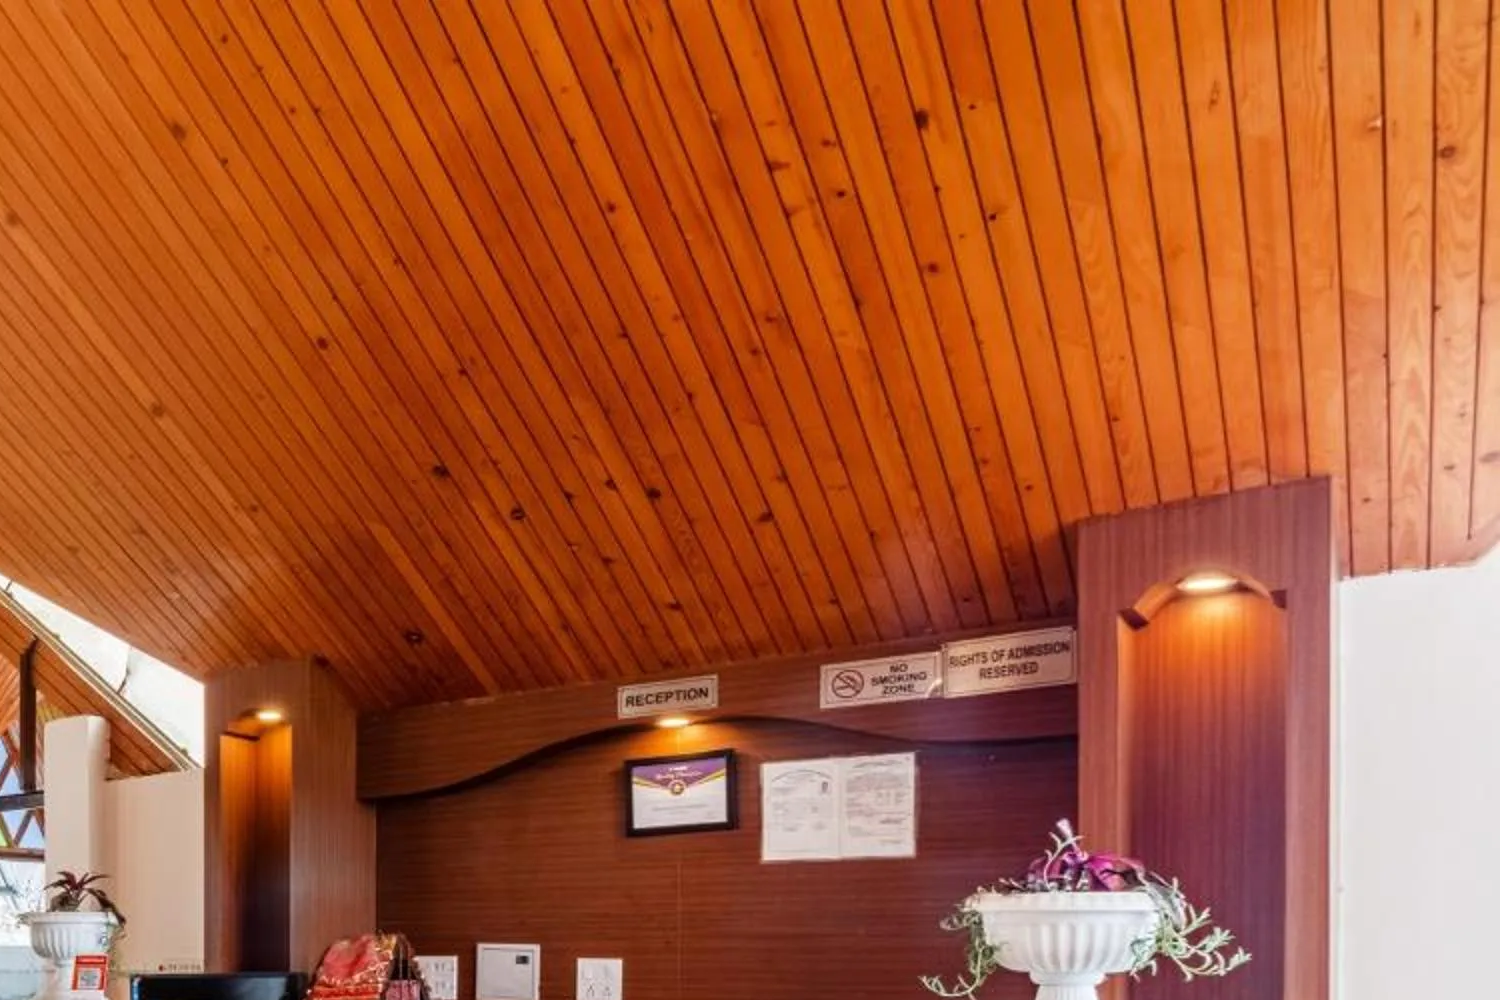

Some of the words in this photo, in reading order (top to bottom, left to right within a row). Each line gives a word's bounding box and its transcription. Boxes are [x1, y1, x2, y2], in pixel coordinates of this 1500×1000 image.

[949, 650, 988, 668] RIGHTS
[991, 649, 1005, 663] OF
[1007, 641, 1070, 661] ADMISSION
[889, 663, 909, 673] NO
[980, 661, 1038, 679] RESERVED
[871, 671, 927, 687] SMOKING
[625, 687, 709, 708] RECEPTION
[883, 683, 916, 695] ZONE
